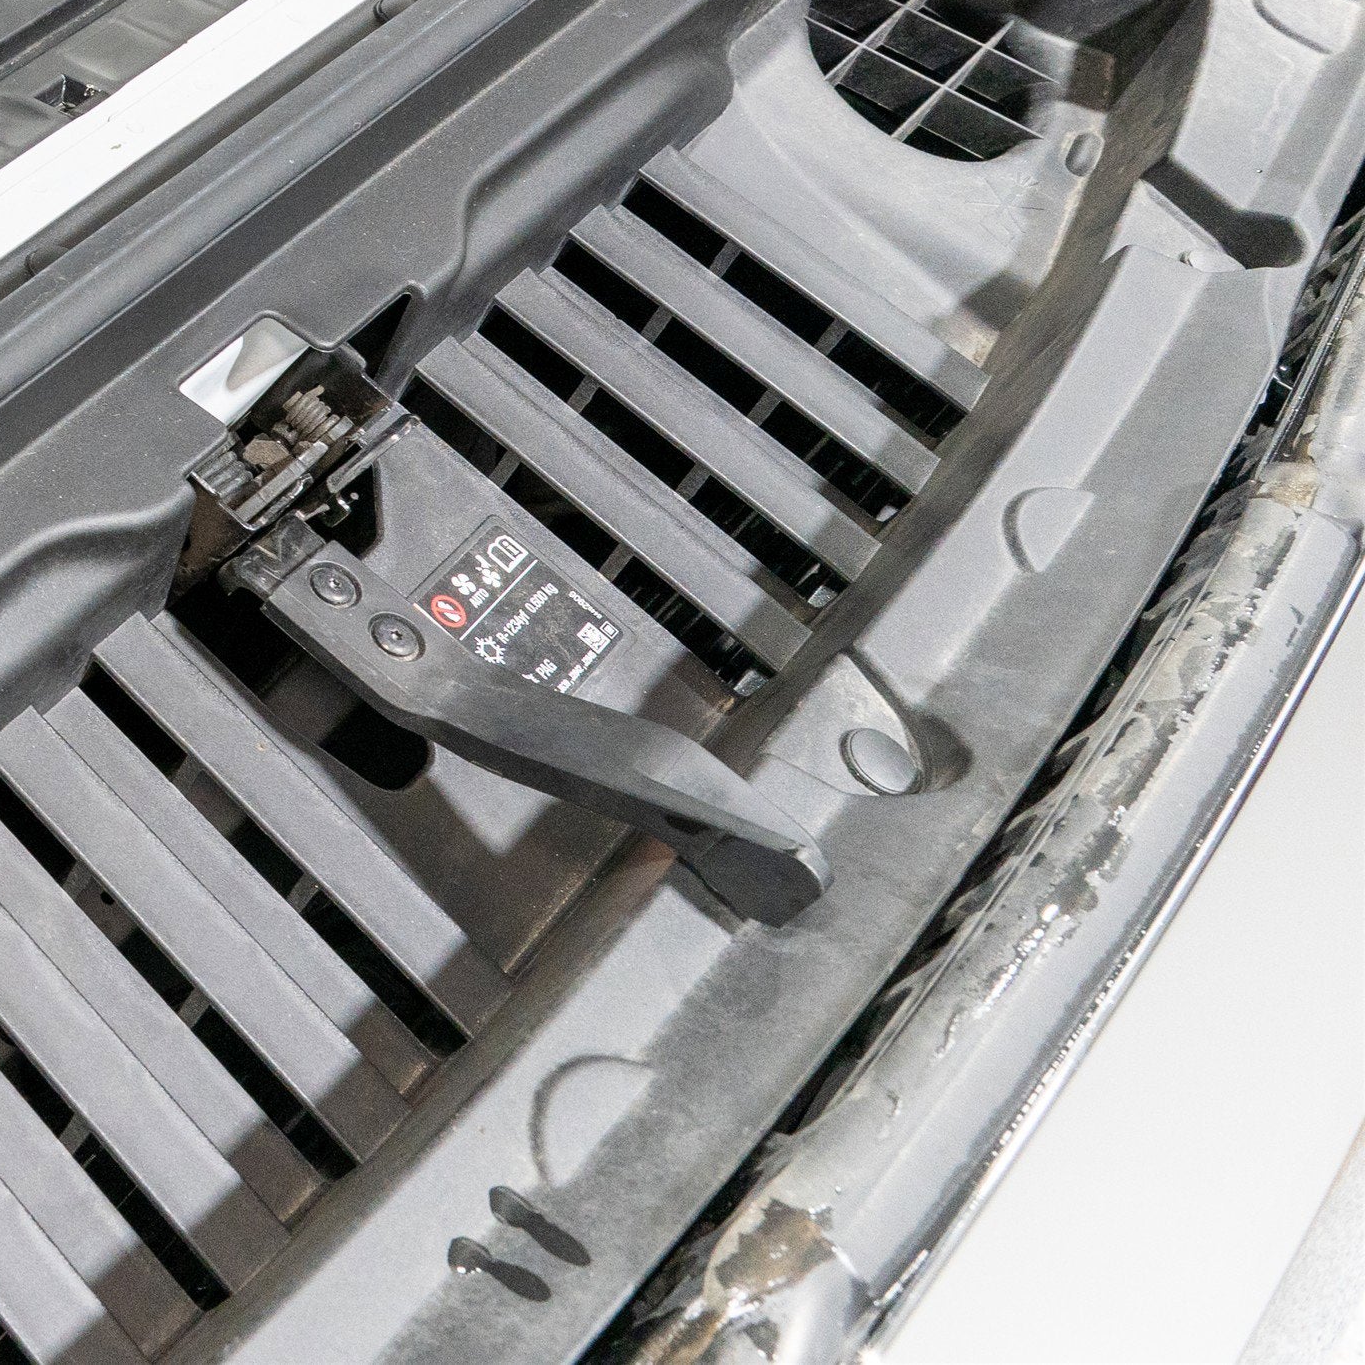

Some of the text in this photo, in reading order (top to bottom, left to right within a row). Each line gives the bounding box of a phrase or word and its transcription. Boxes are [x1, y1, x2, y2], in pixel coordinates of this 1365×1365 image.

[469, 588, 489, 608] AUTO
[496, 582, 559, 644] R-1234yf 0.600 kg
[535, 659, 558, 680] PAG
